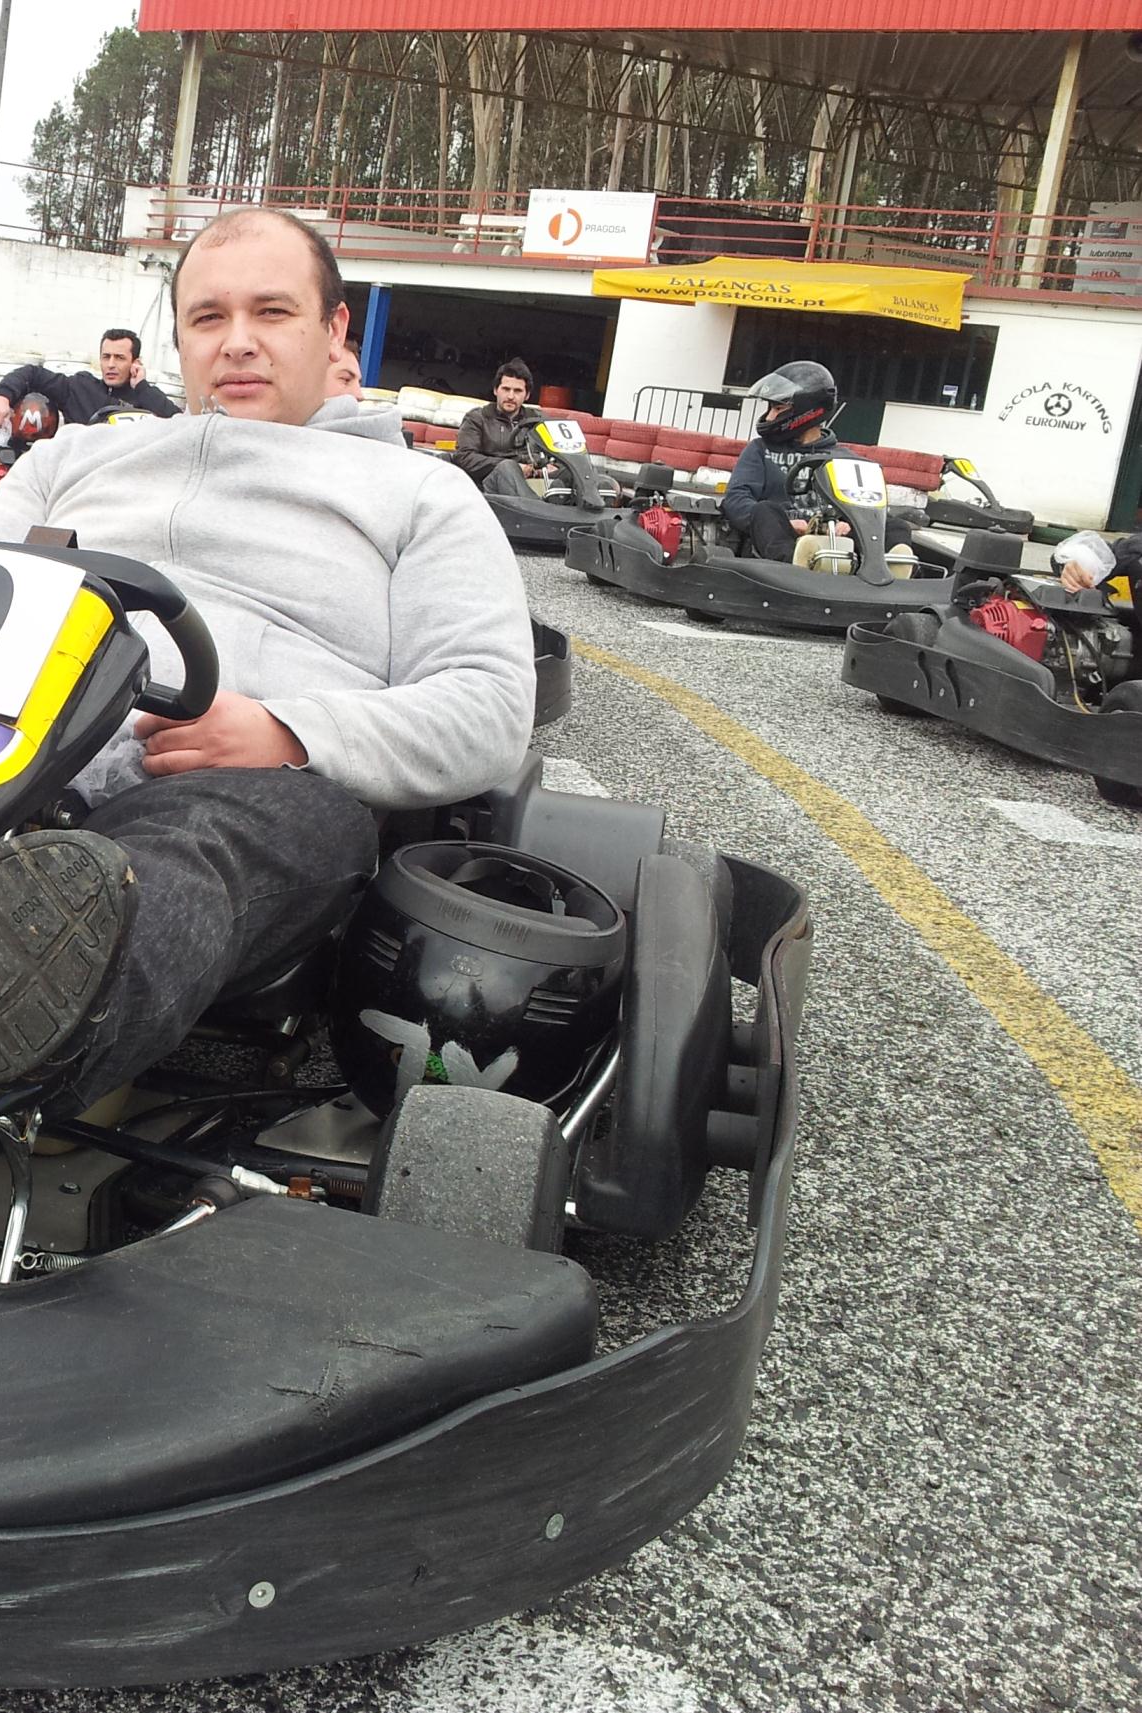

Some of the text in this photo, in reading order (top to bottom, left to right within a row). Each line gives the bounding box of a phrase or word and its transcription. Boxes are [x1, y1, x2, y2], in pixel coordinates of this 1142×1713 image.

[585, 223, 627, 233] PRAGOSA
[635, 287, 827, 307] www.pestronix.pt
[893, 295, 939, 312] BALANÇAS
[998, 382, 1113, 434] ESCOLA KARTING
[557, 422, 573, 440] 6
[1025, 416, 1086, 431] EUROINDY
[854, 463, 864, 488] 1
